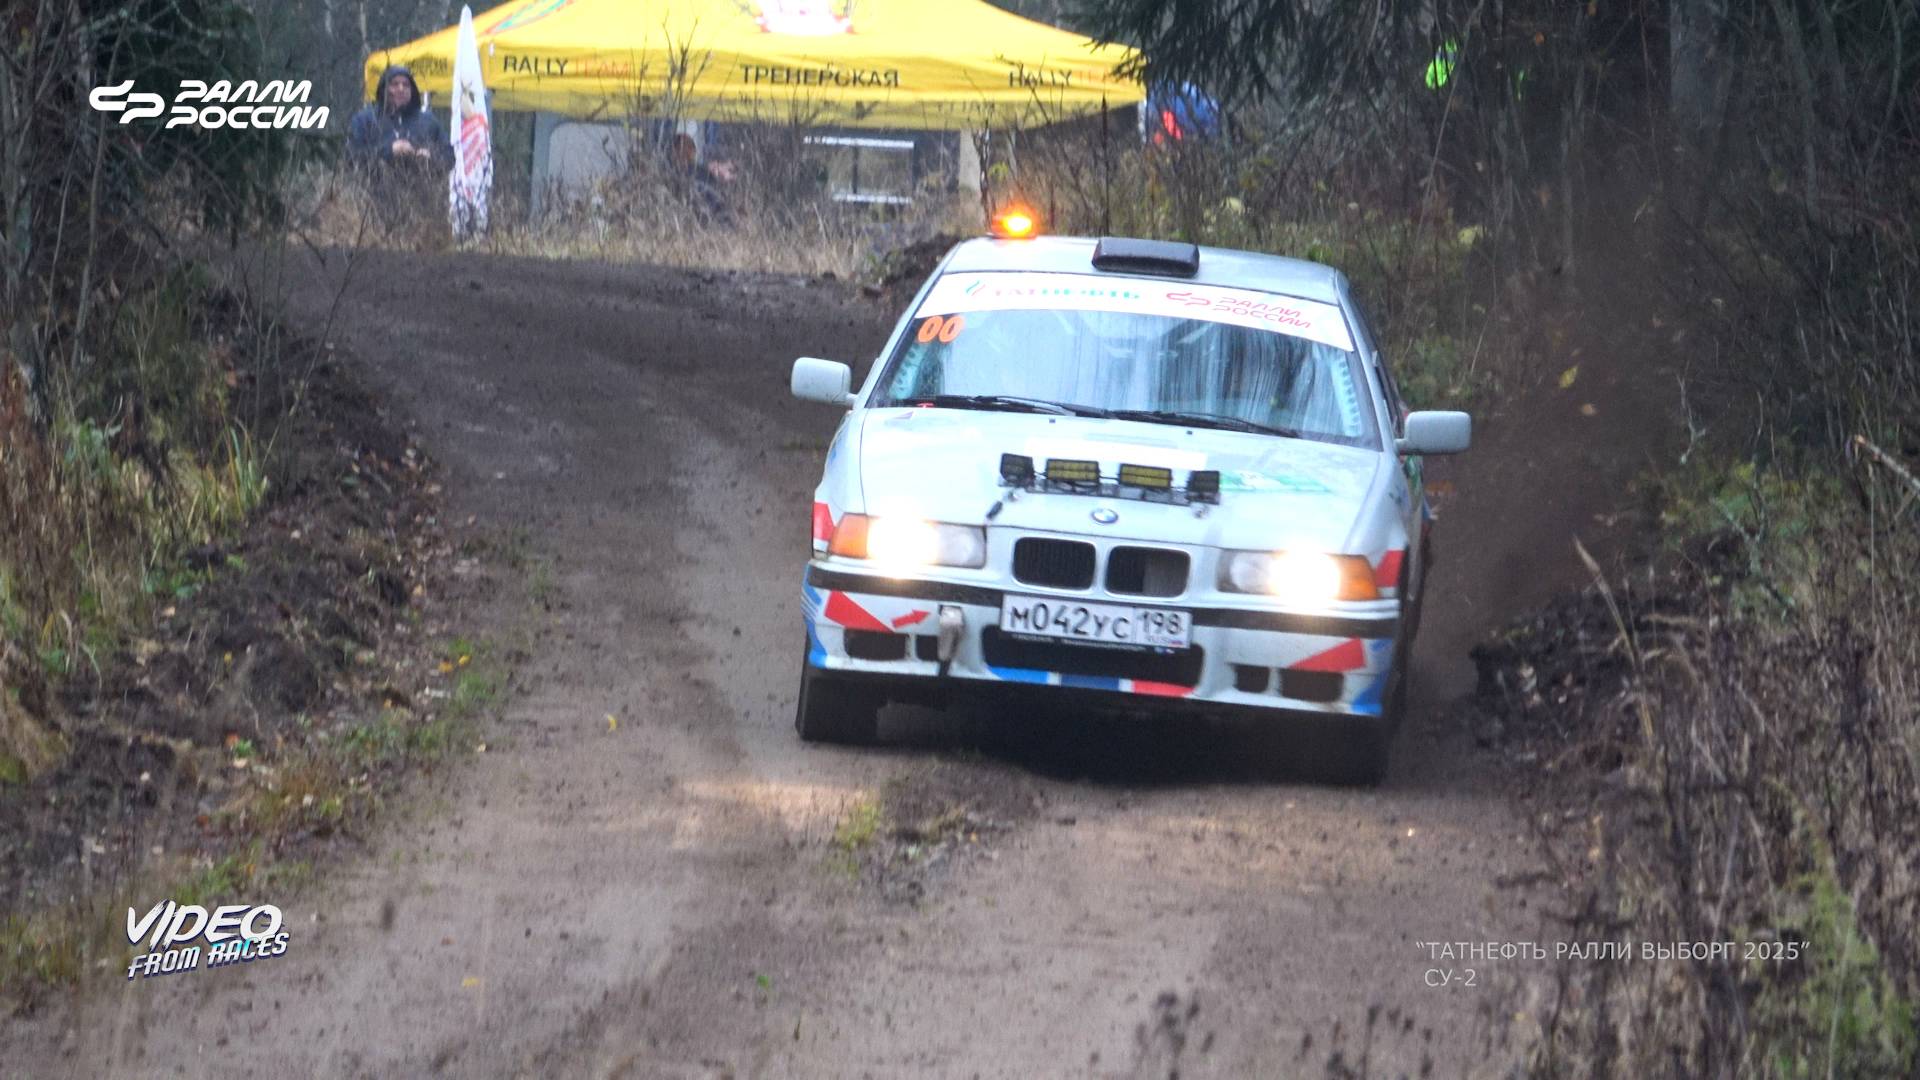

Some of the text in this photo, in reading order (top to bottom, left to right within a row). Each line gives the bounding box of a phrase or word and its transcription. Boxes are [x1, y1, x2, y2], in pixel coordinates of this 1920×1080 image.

[503, 56, 568, 76] RALLY
[740, 63, 899, 88] ТРЕНЕРСКАЯ
[1212, 305, 1312, 329] РОССИИ
[1219, 296, 1301, 318] РАЛЛИ
[917, 315, 966, 344] 00
[1138, 611, 1184, 636] 198
